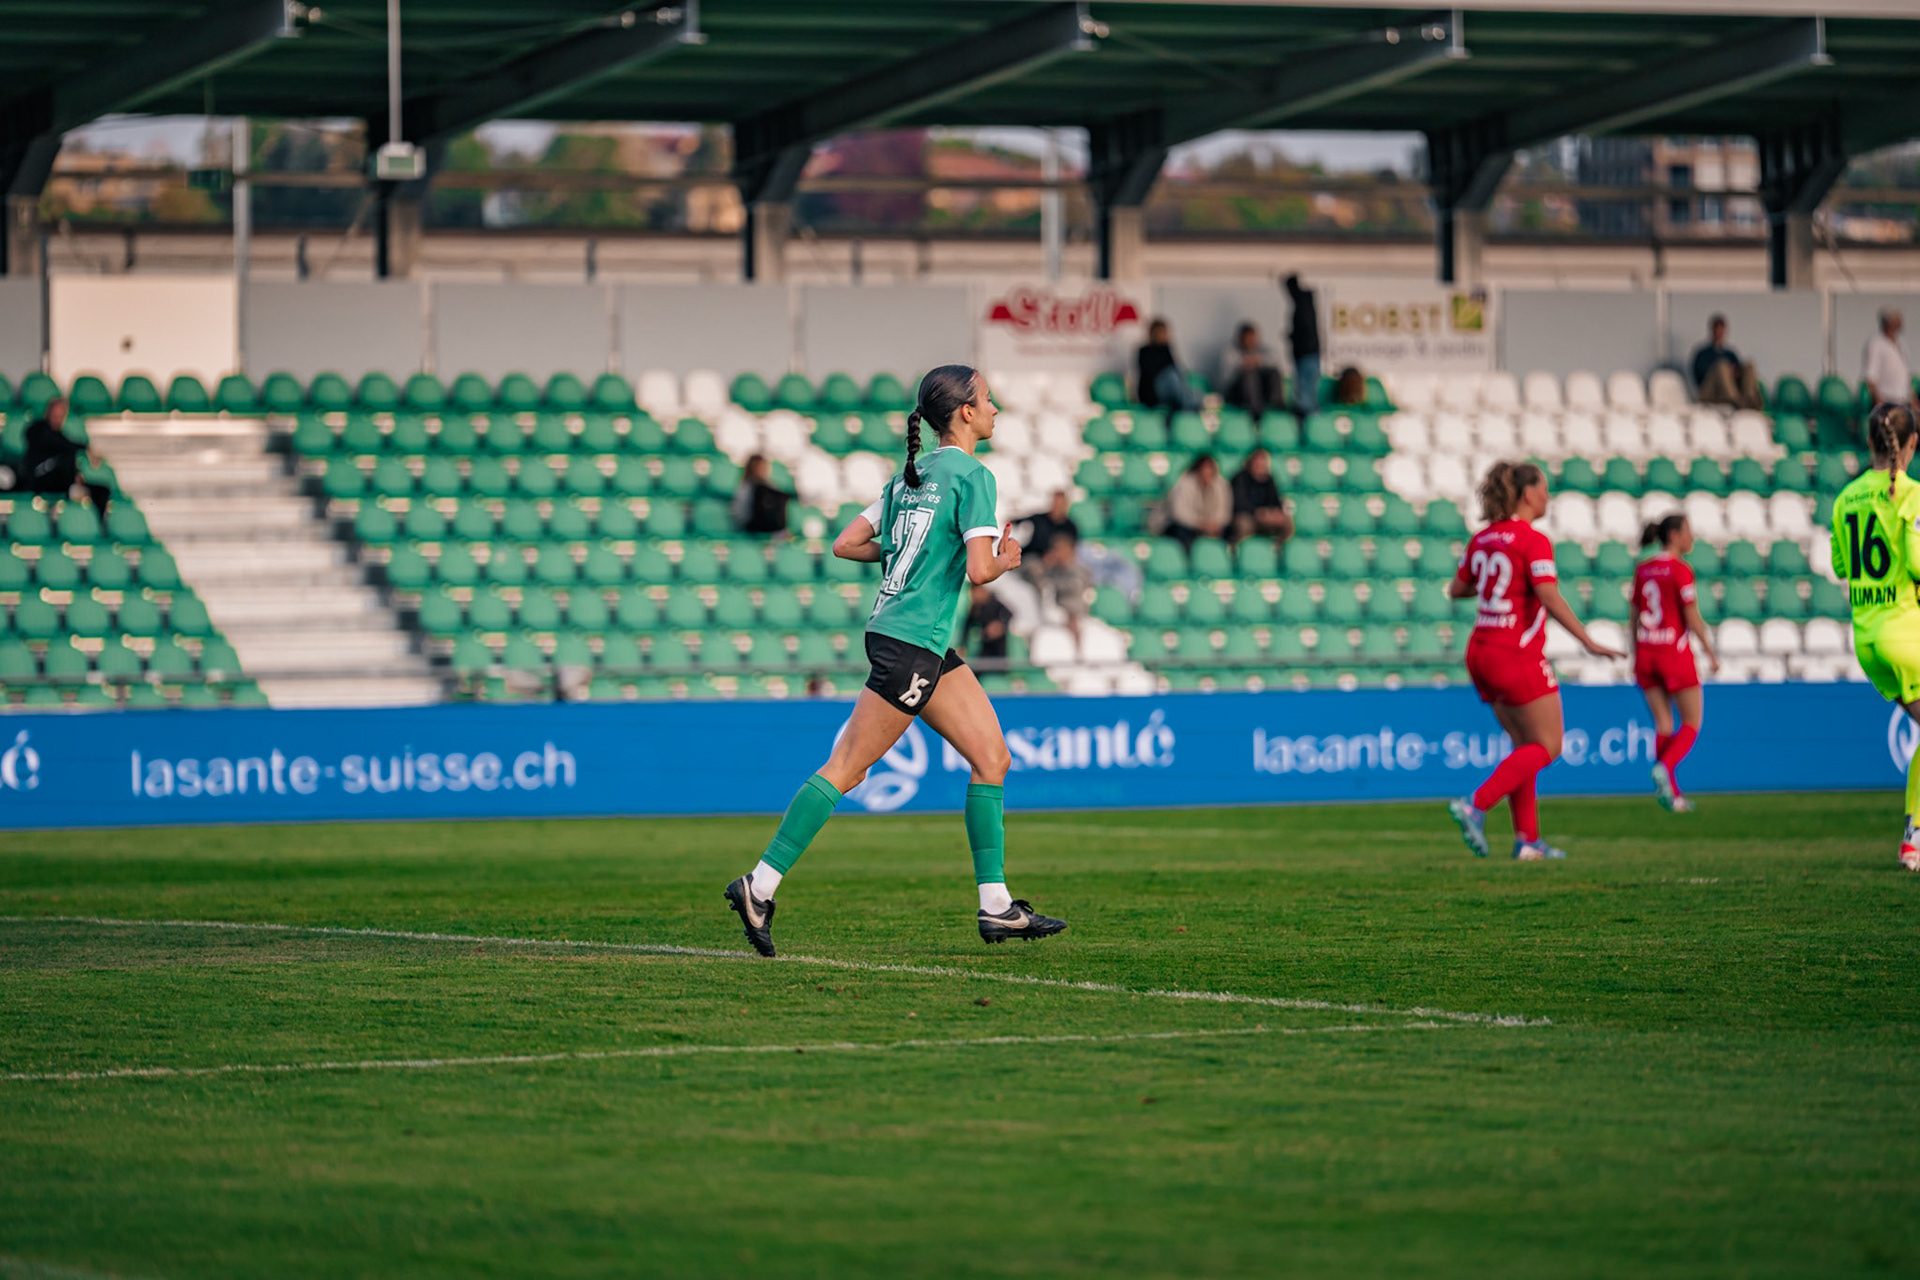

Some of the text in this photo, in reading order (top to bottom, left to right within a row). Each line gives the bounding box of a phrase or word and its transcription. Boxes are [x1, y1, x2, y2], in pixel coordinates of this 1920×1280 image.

[1845, 512, 1891, 580] 16
[1471, 549, 1513, 614] 22
[1640, 578, 1663, 629] 3
[131, 741, 577, 798] lasante-suisse.ch
